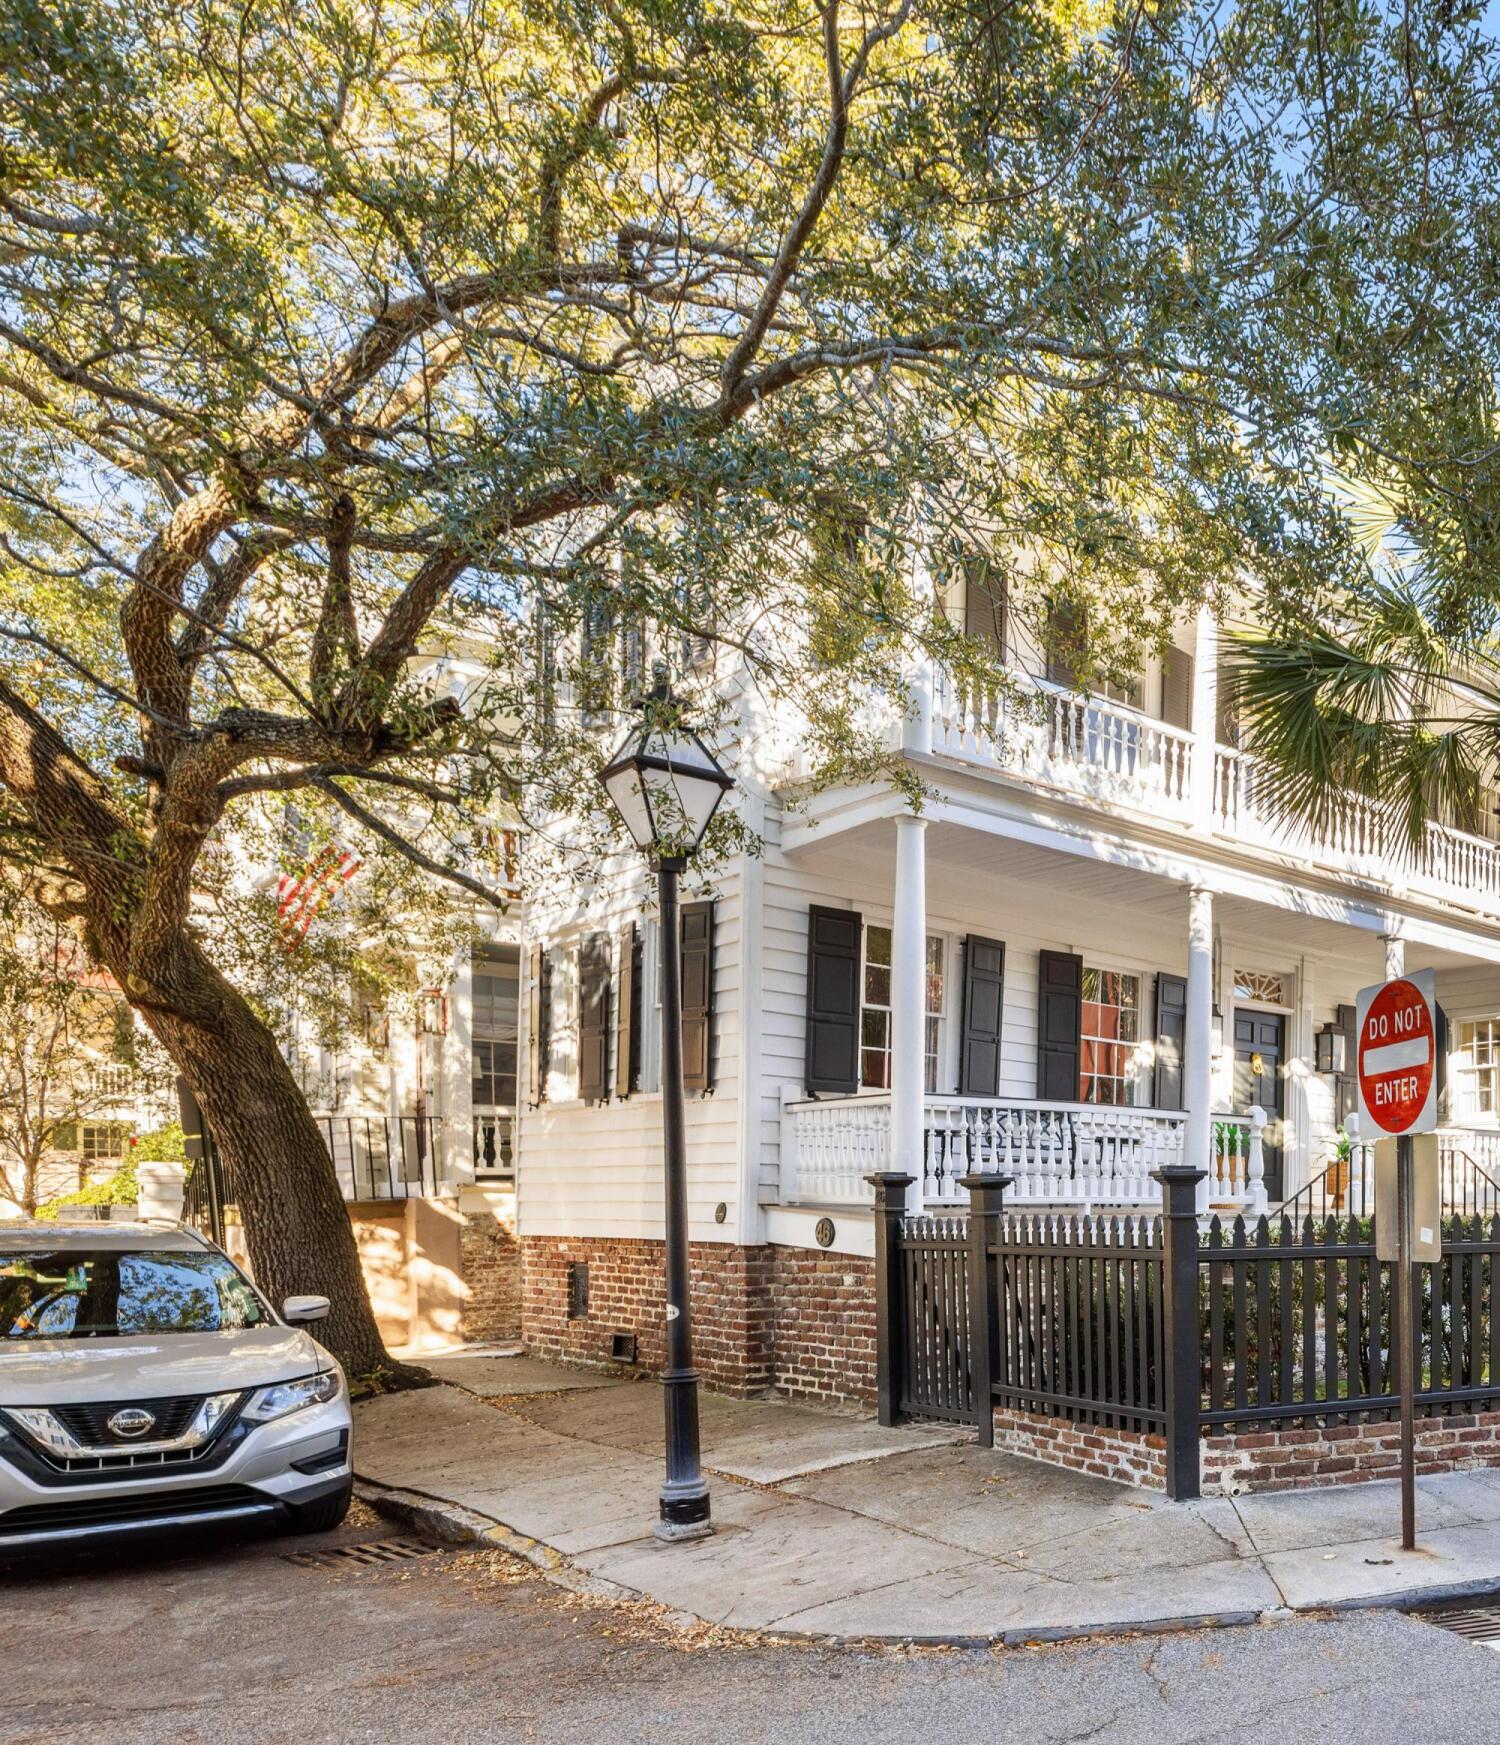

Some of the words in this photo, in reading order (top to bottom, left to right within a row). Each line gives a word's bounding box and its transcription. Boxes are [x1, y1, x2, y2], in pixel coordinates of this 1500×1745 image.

[1369, 1014, 1388, 1040] DO
[1394, 1004, 1422, 1034] NOT
[1375, 1076, 1418, 1106] ENTER
[111, 1418, 152, 1429] NISSAN
